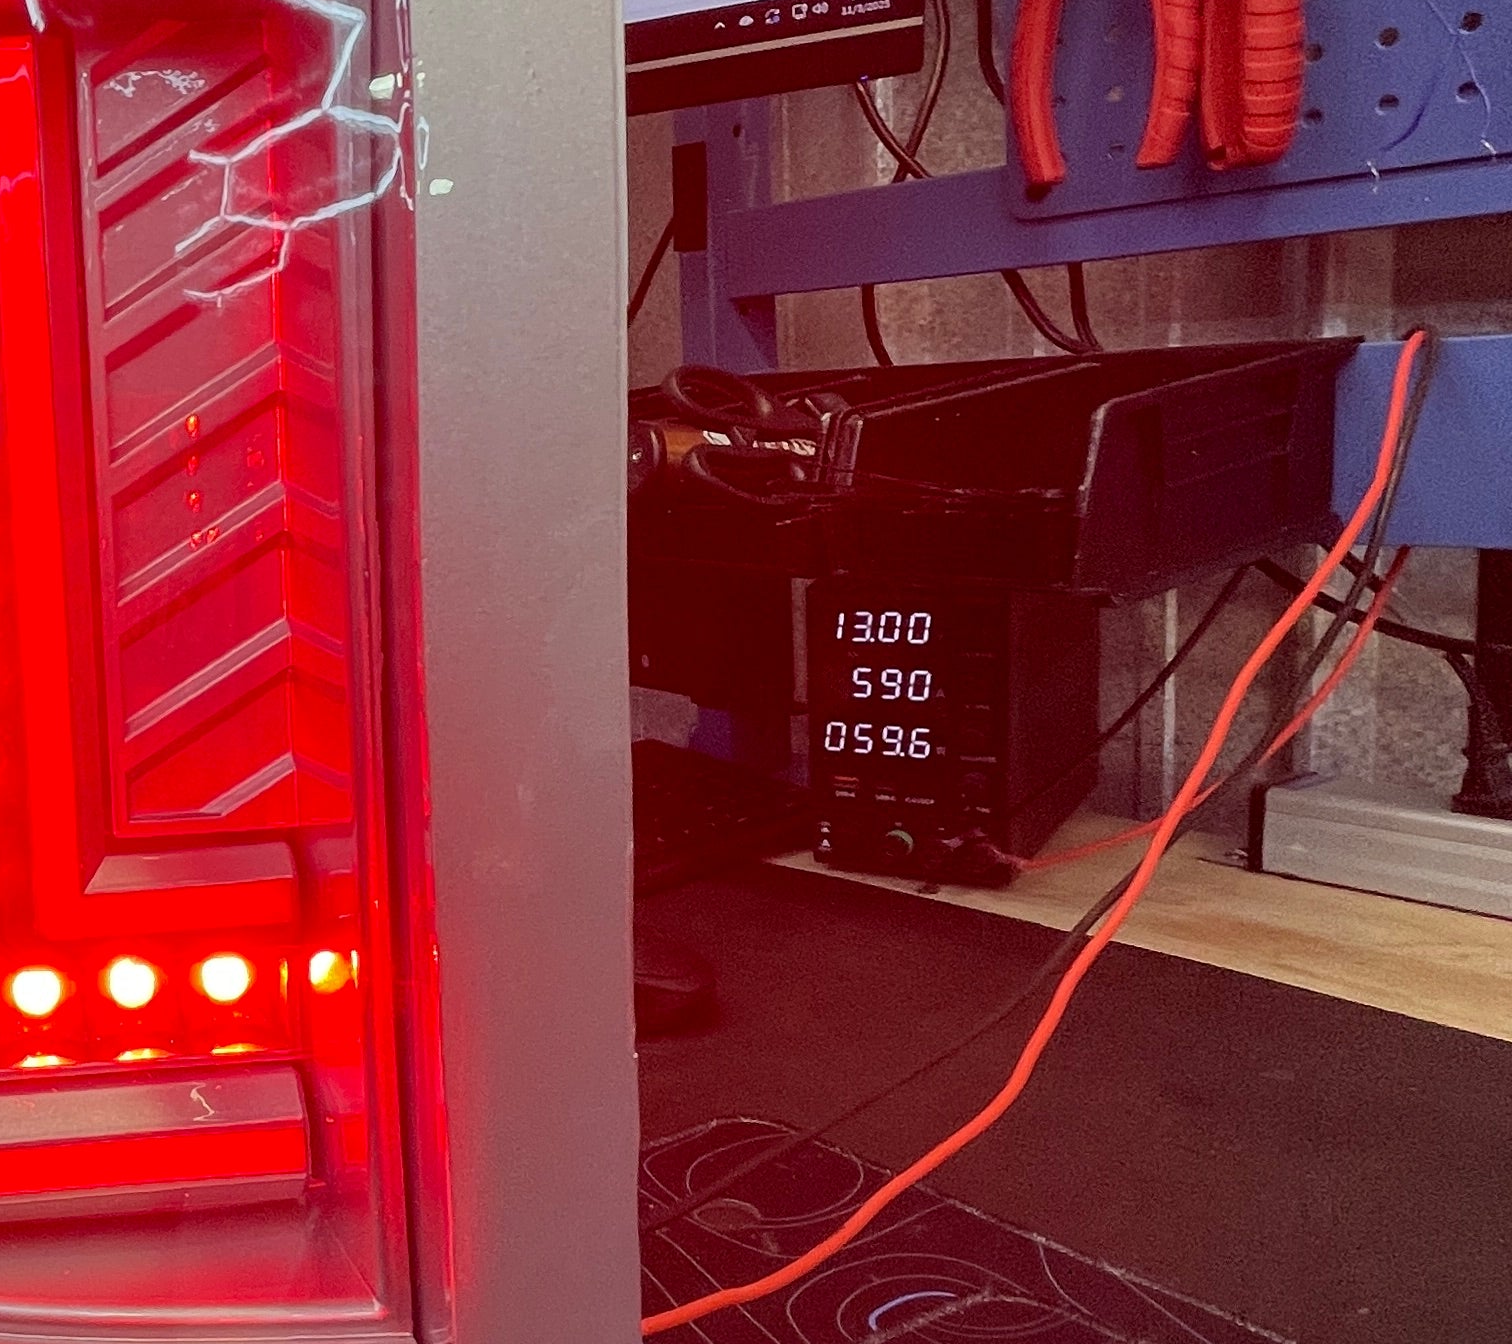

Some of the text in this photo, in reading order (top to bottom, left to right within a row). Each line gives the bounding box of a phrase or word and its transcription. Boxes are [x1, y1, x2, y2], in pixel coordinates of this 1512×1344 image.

[836, 611, 932, 645] 13.00
[852, 667, 933, 702] 590
[824, 721, 931, 759] 059.6
